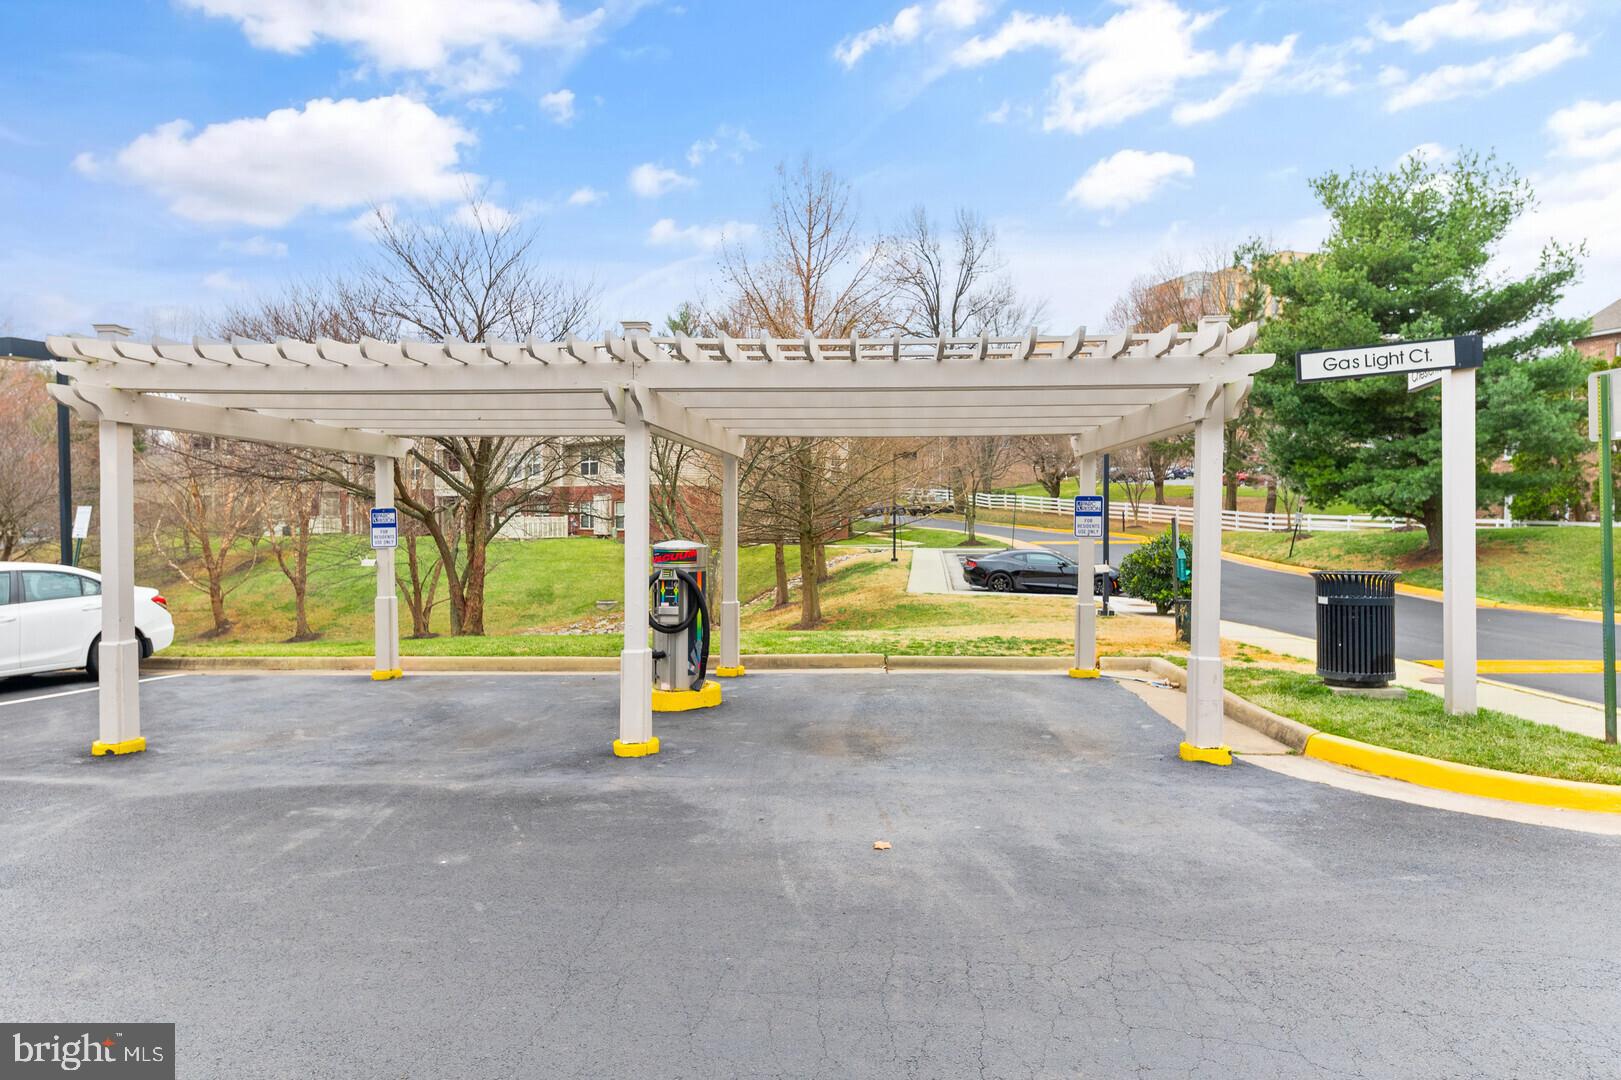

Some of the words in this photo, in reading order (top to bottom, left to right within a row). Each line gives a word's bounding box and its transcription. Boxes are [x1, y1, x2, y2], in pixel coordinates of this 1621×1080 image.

[1323, 357, 1360, 371] Gas
[1365, 350, 1404, 370] Light
[1409, 348, 1433, 364] Ct.
[652, 549, 698, 563] VACUUM
